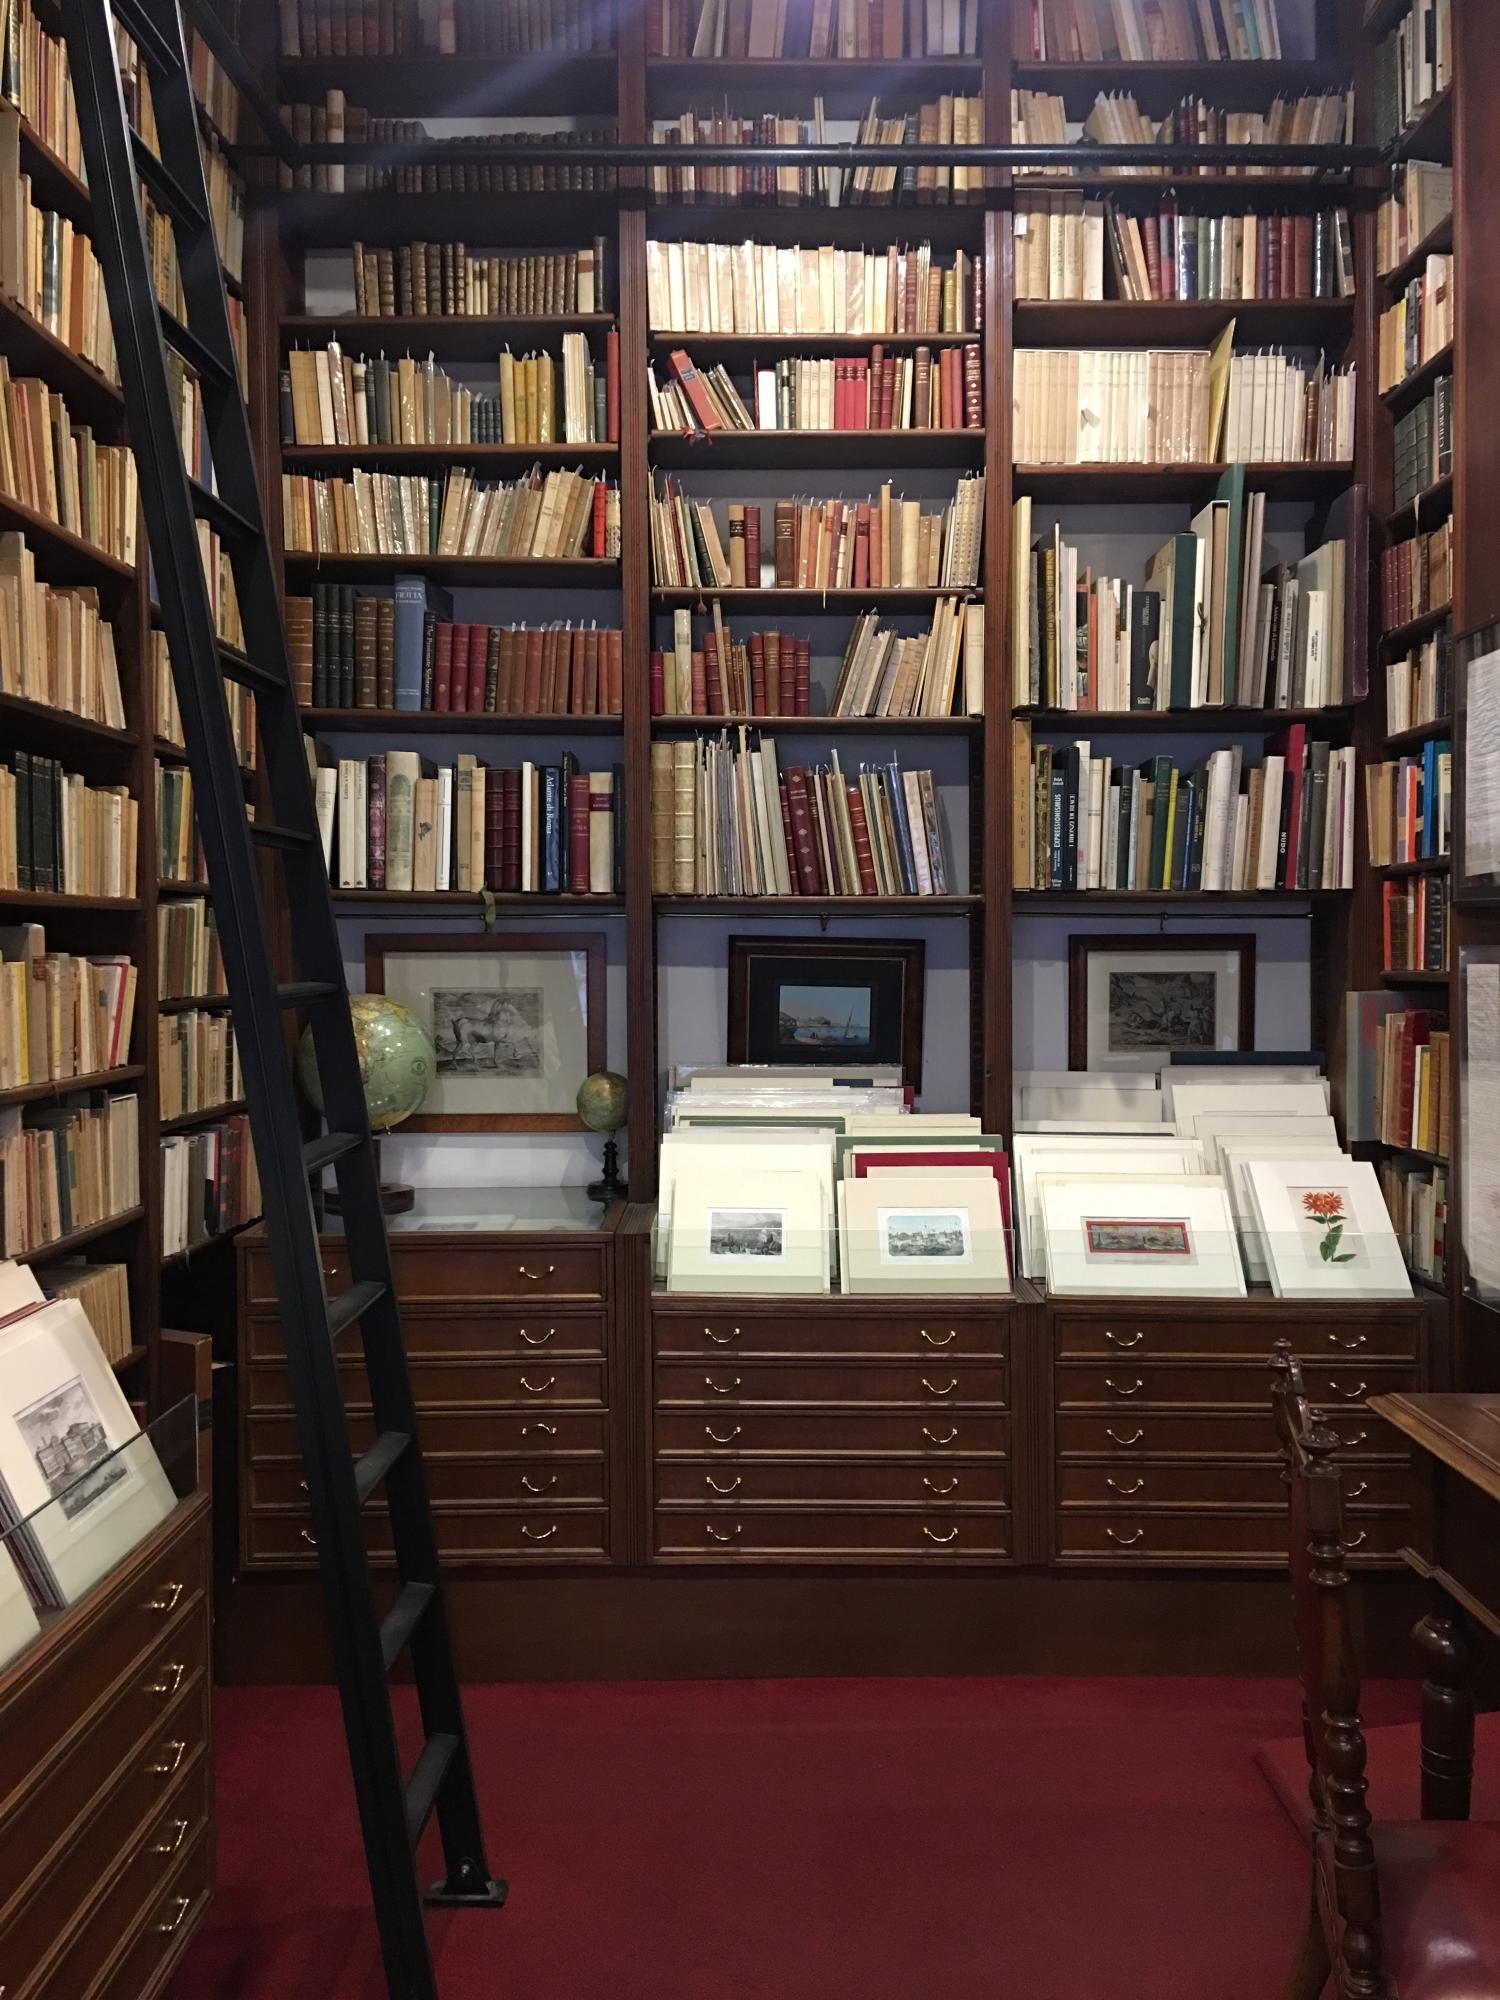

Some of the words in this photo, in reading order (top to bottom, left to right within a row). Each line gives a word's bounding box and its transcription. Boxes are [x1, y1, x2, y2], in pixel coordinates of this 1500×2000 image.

[545, 775, 555, 803] Atlante
[546, 813, 555, 834] Roma
[1053, 794, 1062, 848] EXPRESSIONISMUS
